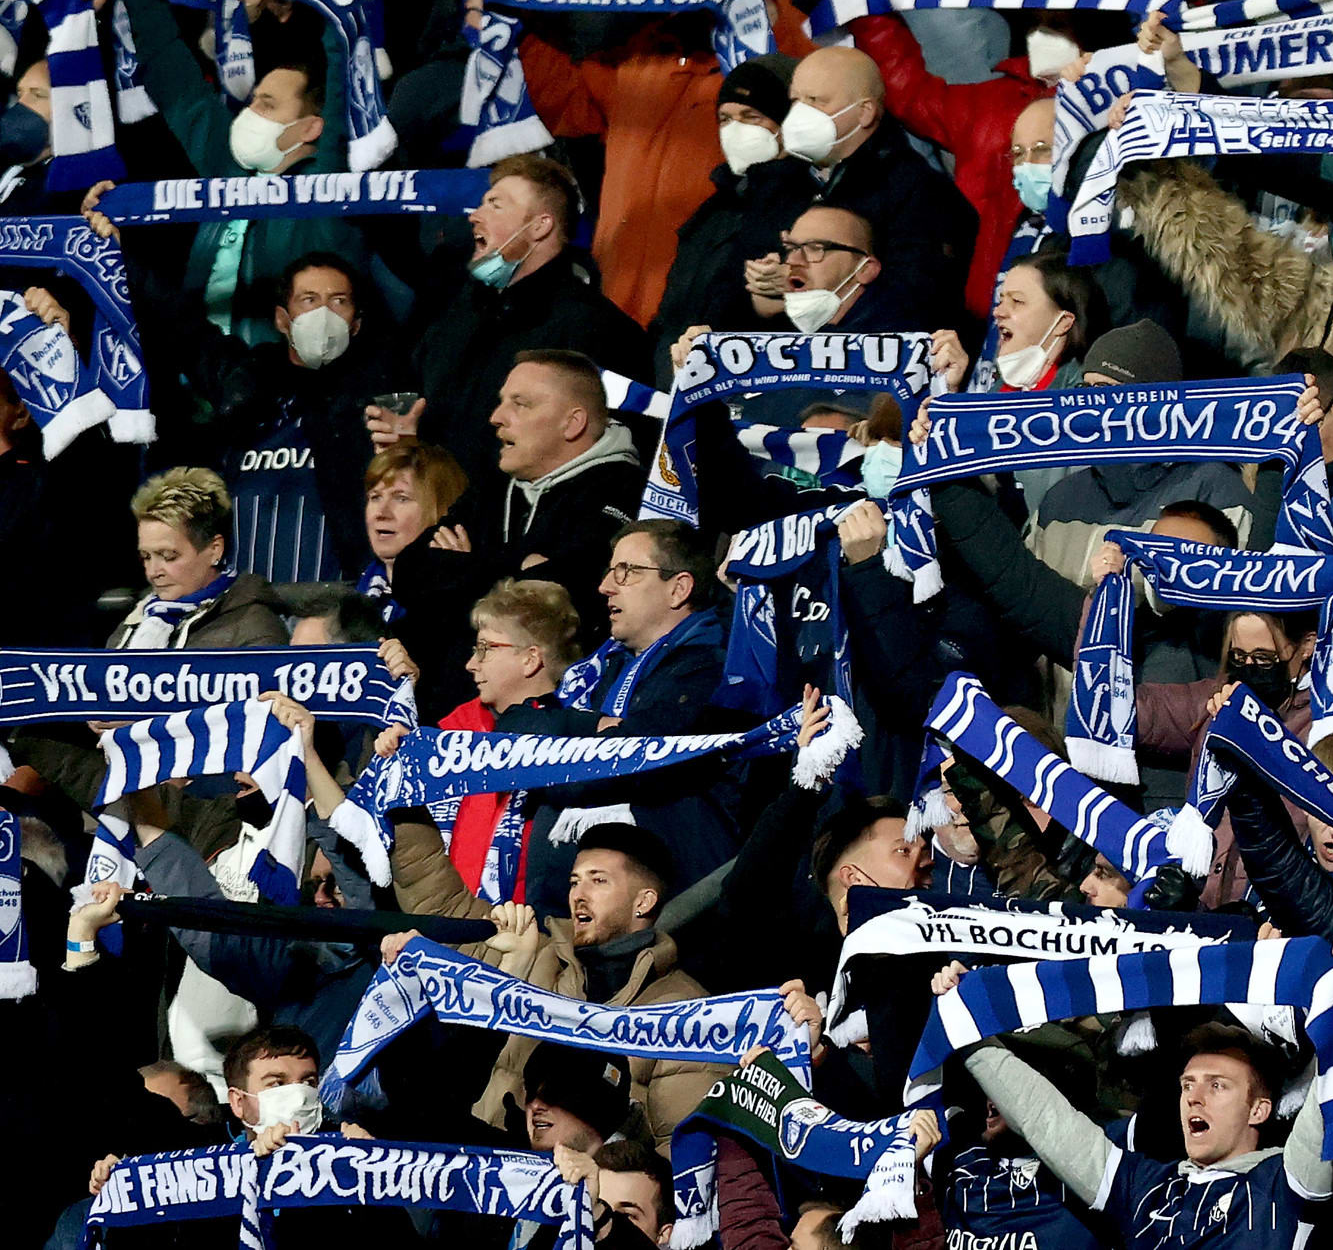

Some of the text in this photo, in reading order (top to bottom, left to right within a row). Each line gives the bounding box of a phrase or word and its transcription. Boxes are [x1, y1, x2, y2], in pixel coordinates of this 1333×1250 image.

[1260, 130, 1301, 150] Seit
[822, 374, 866, 385] BOCHUM
[1060, 390, 1180, 407] MEIN VEREIN
[990, 401, 1213, 451] BOCHUM
[31, 660, 368, 703] VfL Bochum 1848
[969, 923, 1119, 957] BOCHUM
[741, 1065, 786, 1102] HERZEN
[731, 1081, 777, 1129] VON HIER.
[140, 1157, 217, 1210] FANS
